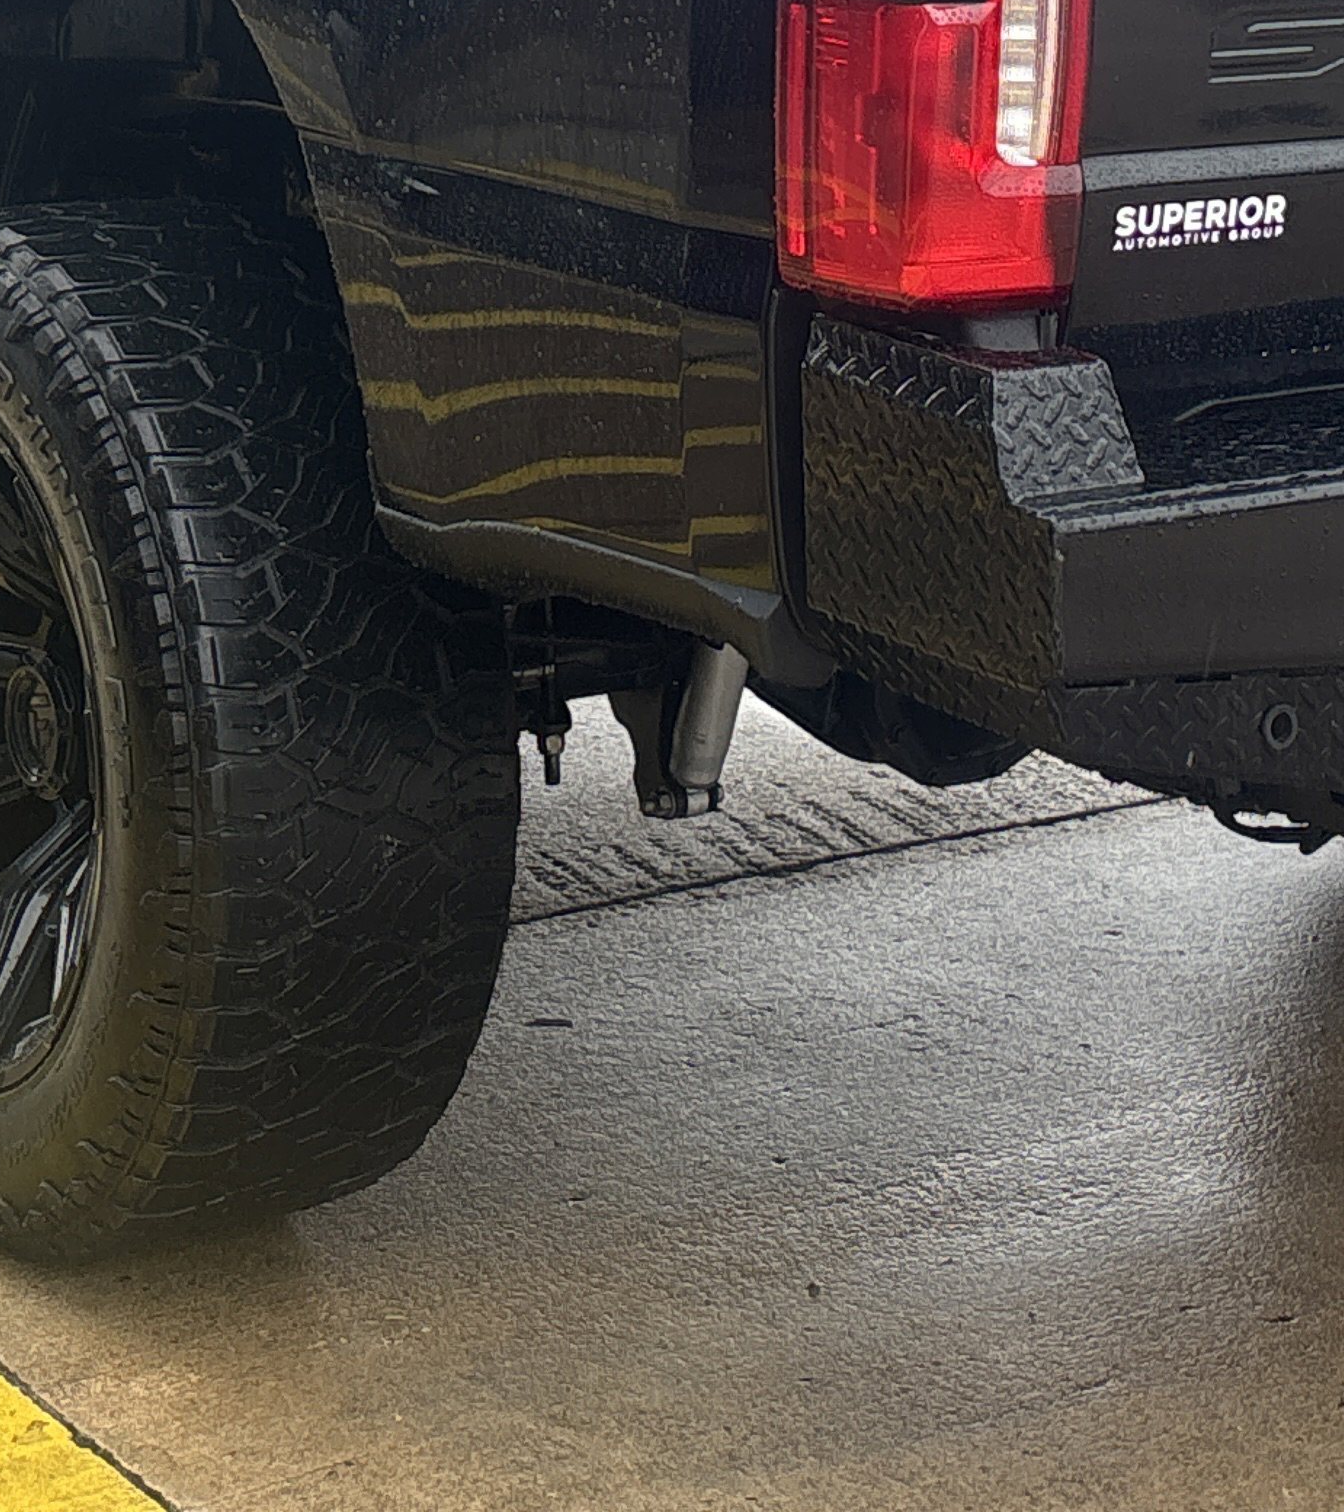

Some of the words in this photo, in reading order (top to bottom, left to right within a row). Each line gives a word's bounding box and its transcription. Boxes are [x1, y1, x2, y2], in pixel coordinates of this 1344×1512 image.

[1114, 194, 1287, 238] SUPERIOR
[1112, 230, 1222, 252] AUTOMOTIVE
[1228, 225, 1285, 243] GROUP
